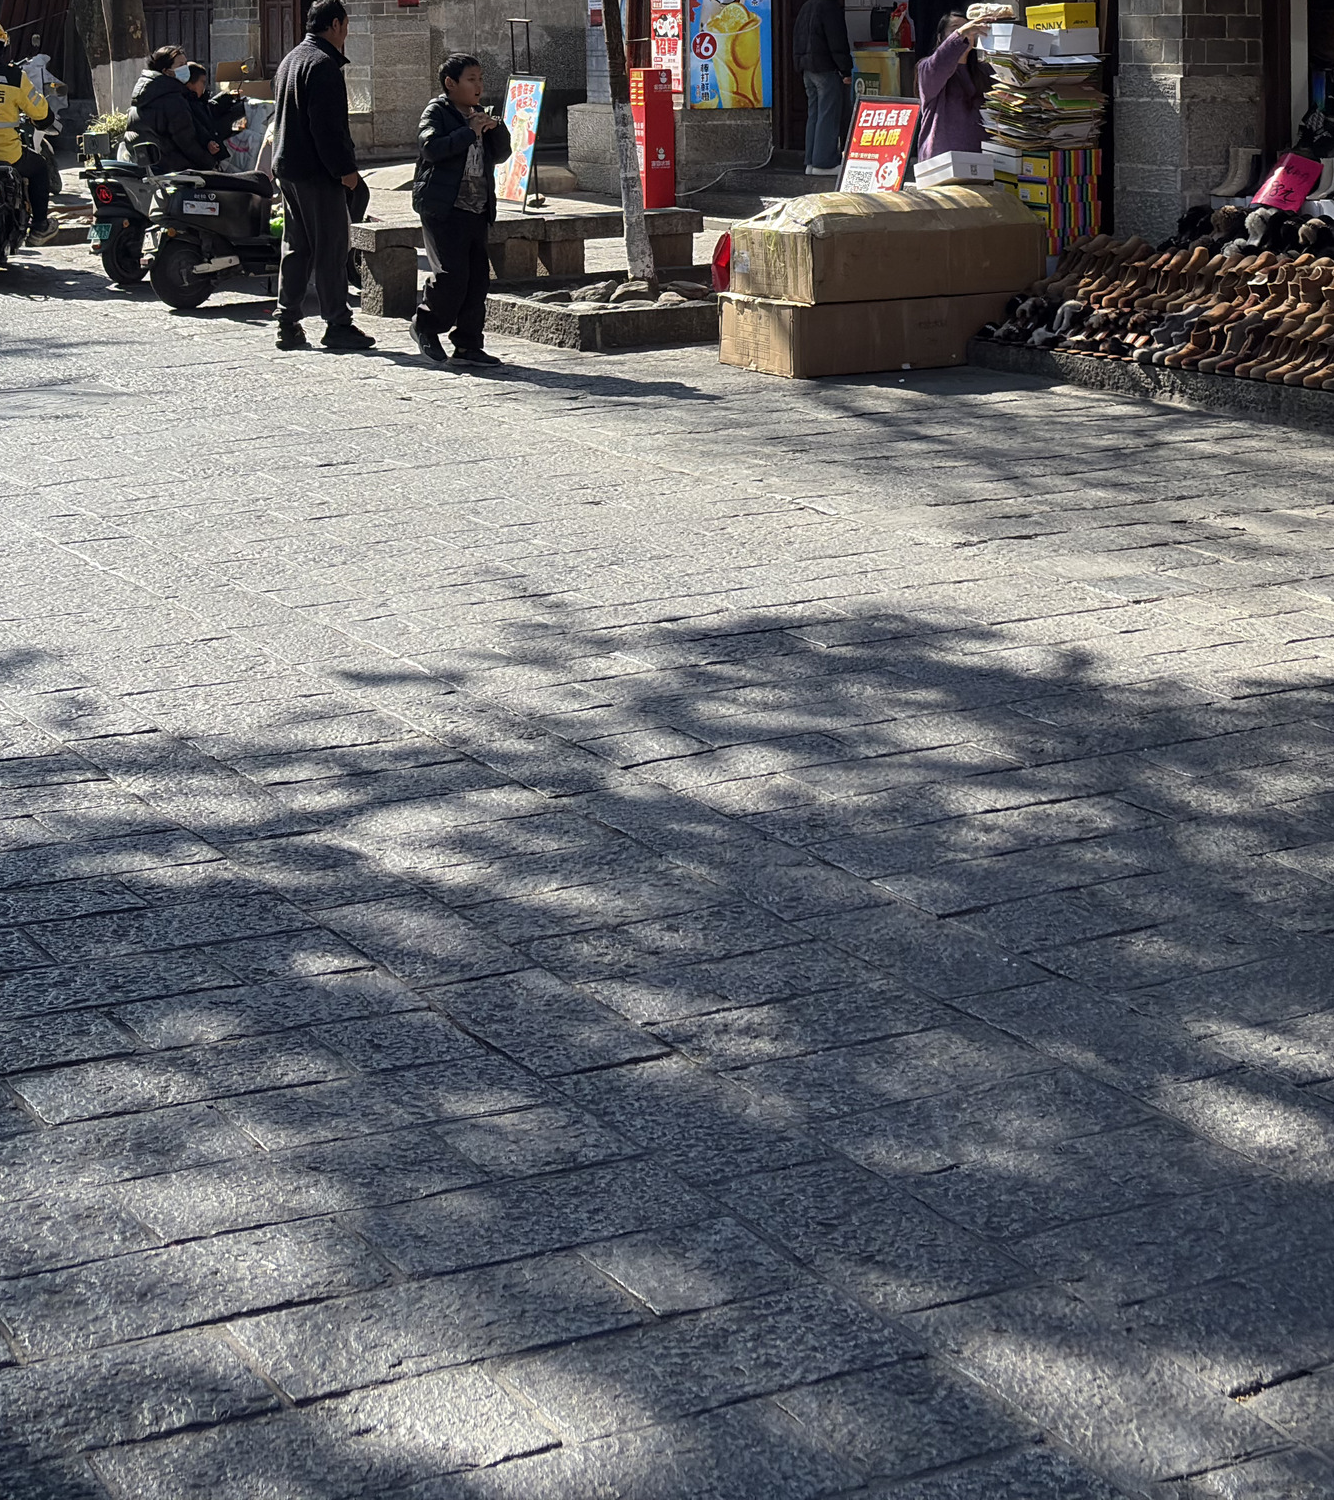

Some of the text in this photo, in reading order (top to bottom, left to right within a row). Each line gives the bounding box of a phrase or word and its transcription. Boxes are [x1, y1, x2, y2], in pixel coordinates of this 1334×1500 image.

[656, 38, 678, 55] 招聘
[858, 109, 913, 127] 扫码点餐
[860, 129, 902, 146] 更快哦
